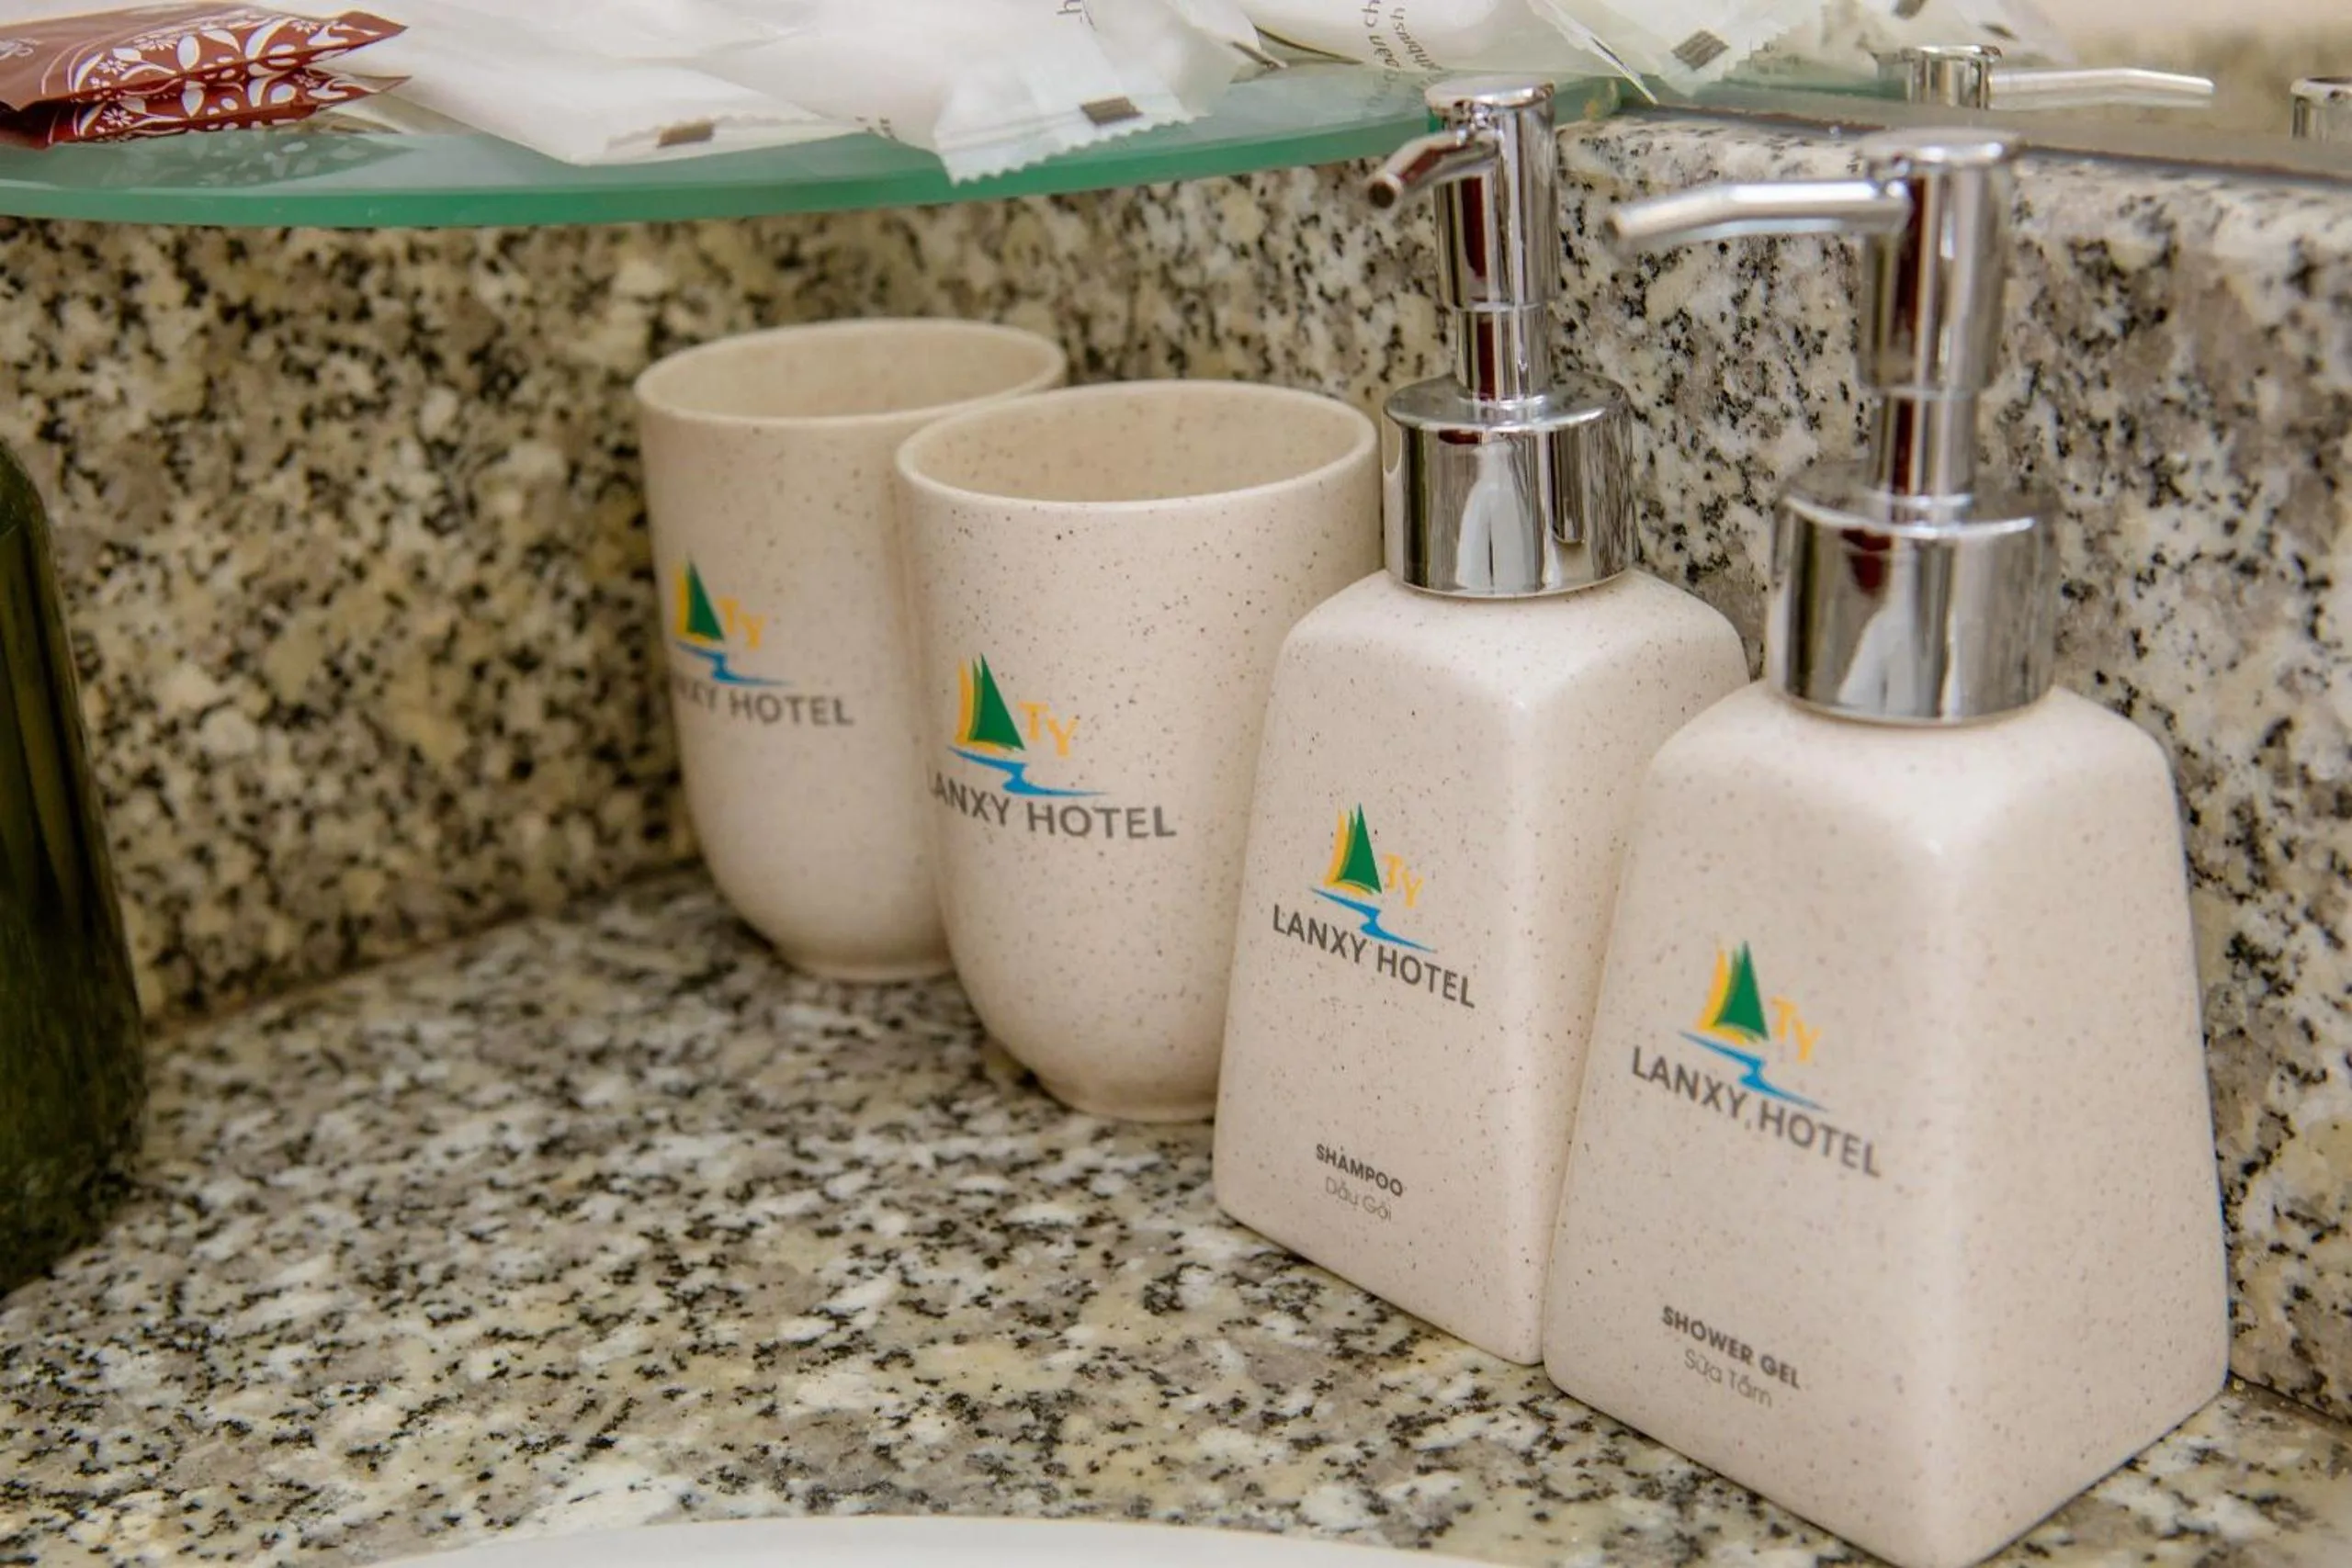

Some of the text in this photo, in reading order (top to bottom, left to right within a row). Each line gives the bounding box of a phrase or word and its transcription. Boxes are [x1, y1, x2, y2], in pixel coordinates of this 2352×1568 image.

[716, 597, 766, 651] TY
[729, 690, 856, 727] HOTEL
[1017, 701, 1080, 758] TY
[1026, 800, 1178, 840] HOTEL
[1383, 852, 1424, 908] TY
[1272, 903, 1476, 1010] LANXY HOTEL
[1771, 997, 1820, 1062] TY
[1631, 1043, 1883, 1179] LANXY HOTEL
[1316, 1143, 1404, 1198] SHAMPOO
[1661, 1304, 1801, 1391] SHOWER GEL
